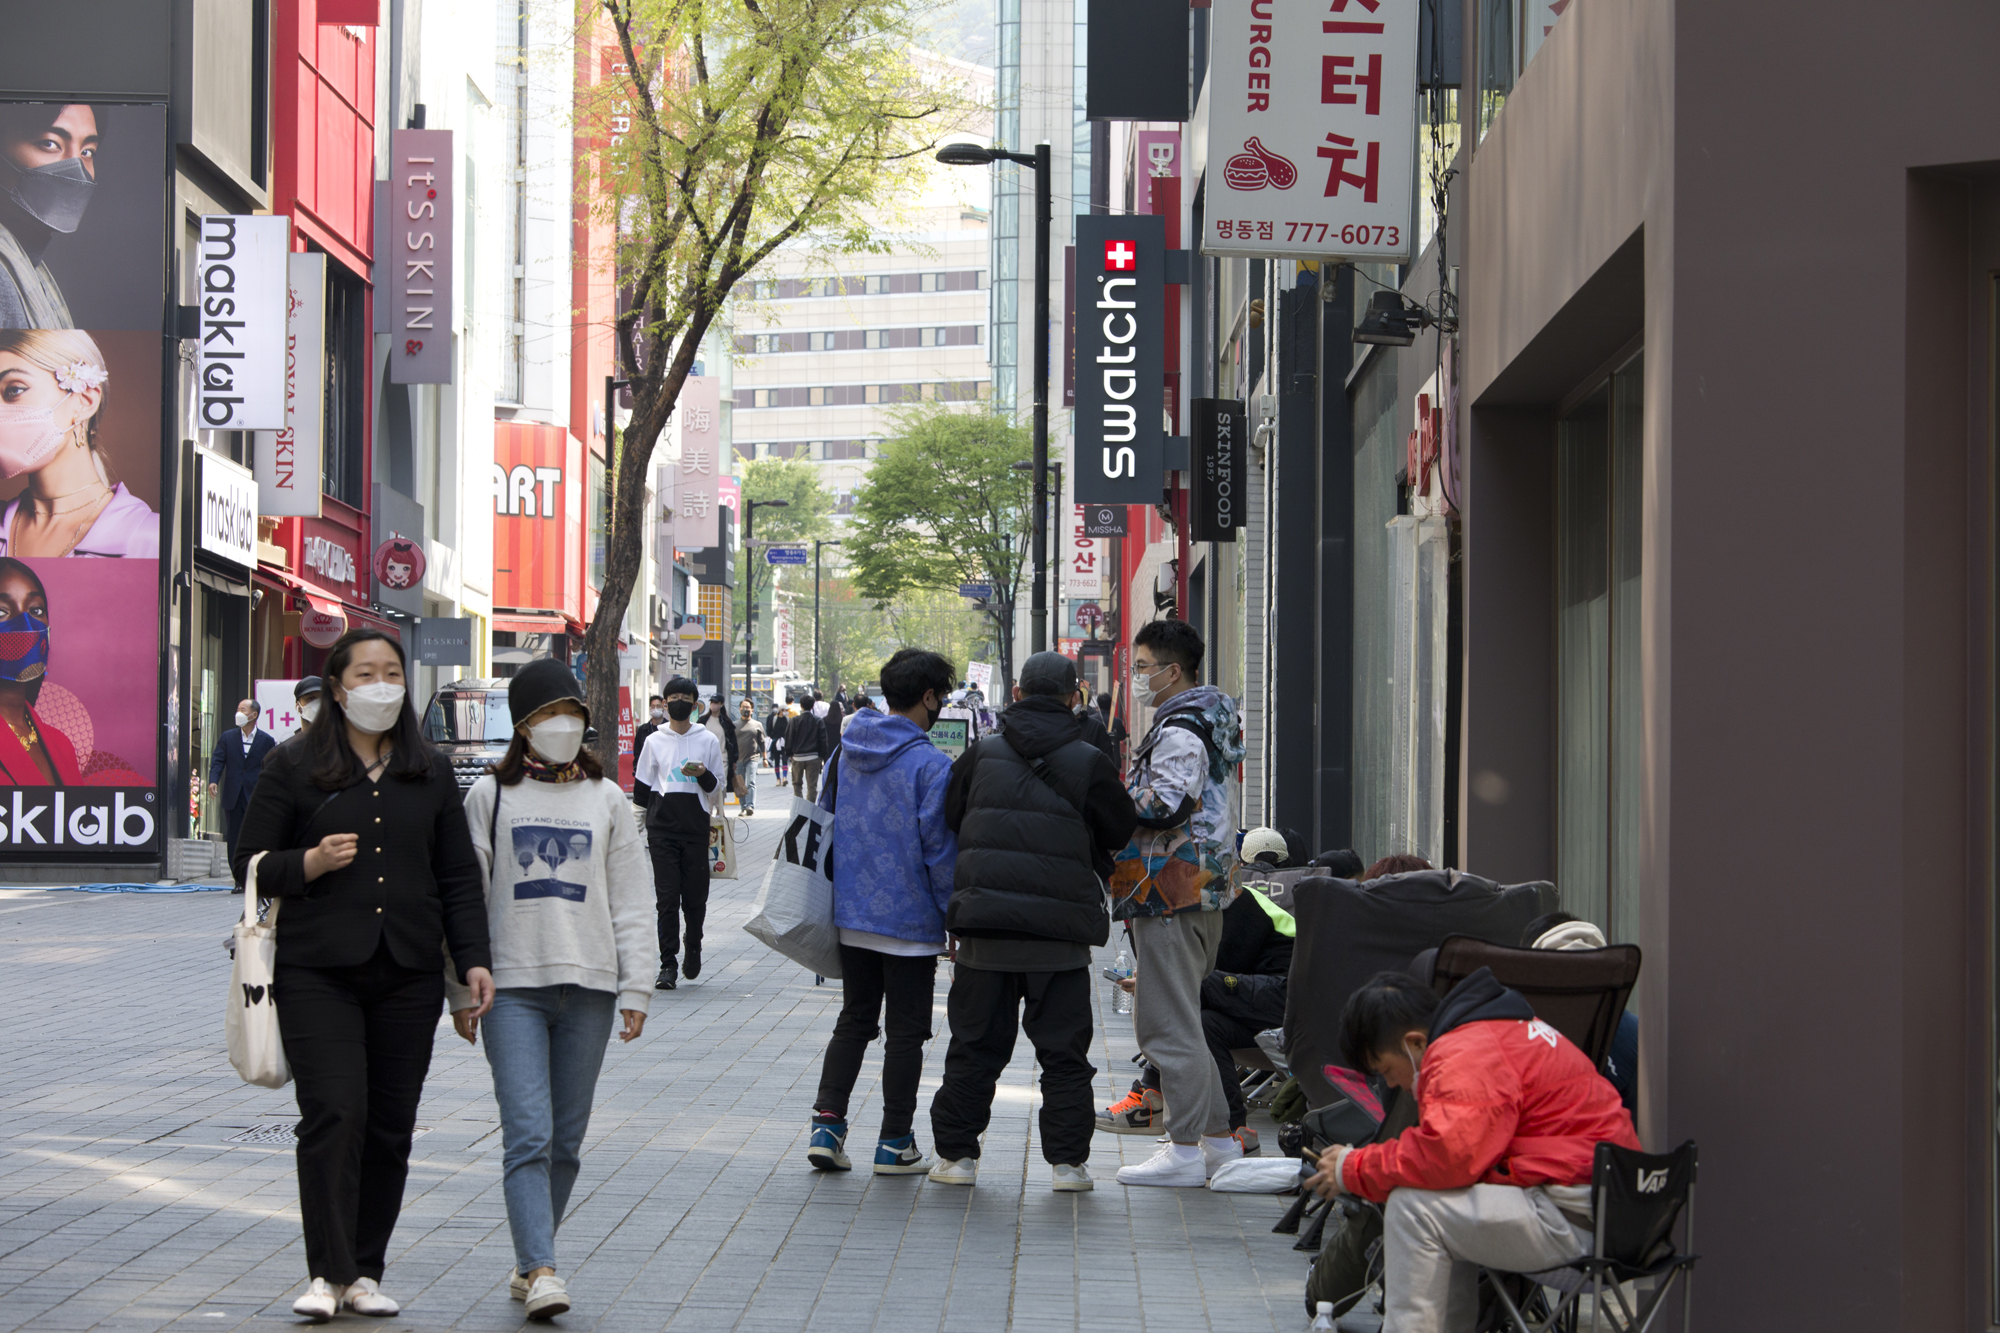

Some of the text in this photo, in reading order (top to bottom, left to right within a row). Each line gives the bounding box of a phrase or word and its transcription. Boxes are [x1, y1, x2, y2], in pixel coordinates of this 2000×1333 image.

[1216, 219, 1400, 247] 명동점 777-6073
[202, 217, 246, 426] masklab
[1096, 277, 1137, 478] swatch
[683, 405, 711, 518] 嗨美詩
[1206, 455, 1215, 482] 1957
[1217, 412, 1231, 528] SKINFOOD
[494, 462, 562, 519] ART
[1088, 525, 1123, 534] MISSHA
[1069, 579, 1098, 587] 773-6622
[511, 817, 532, 825] CITY
[554, 818, 591, 828] COLOUR
